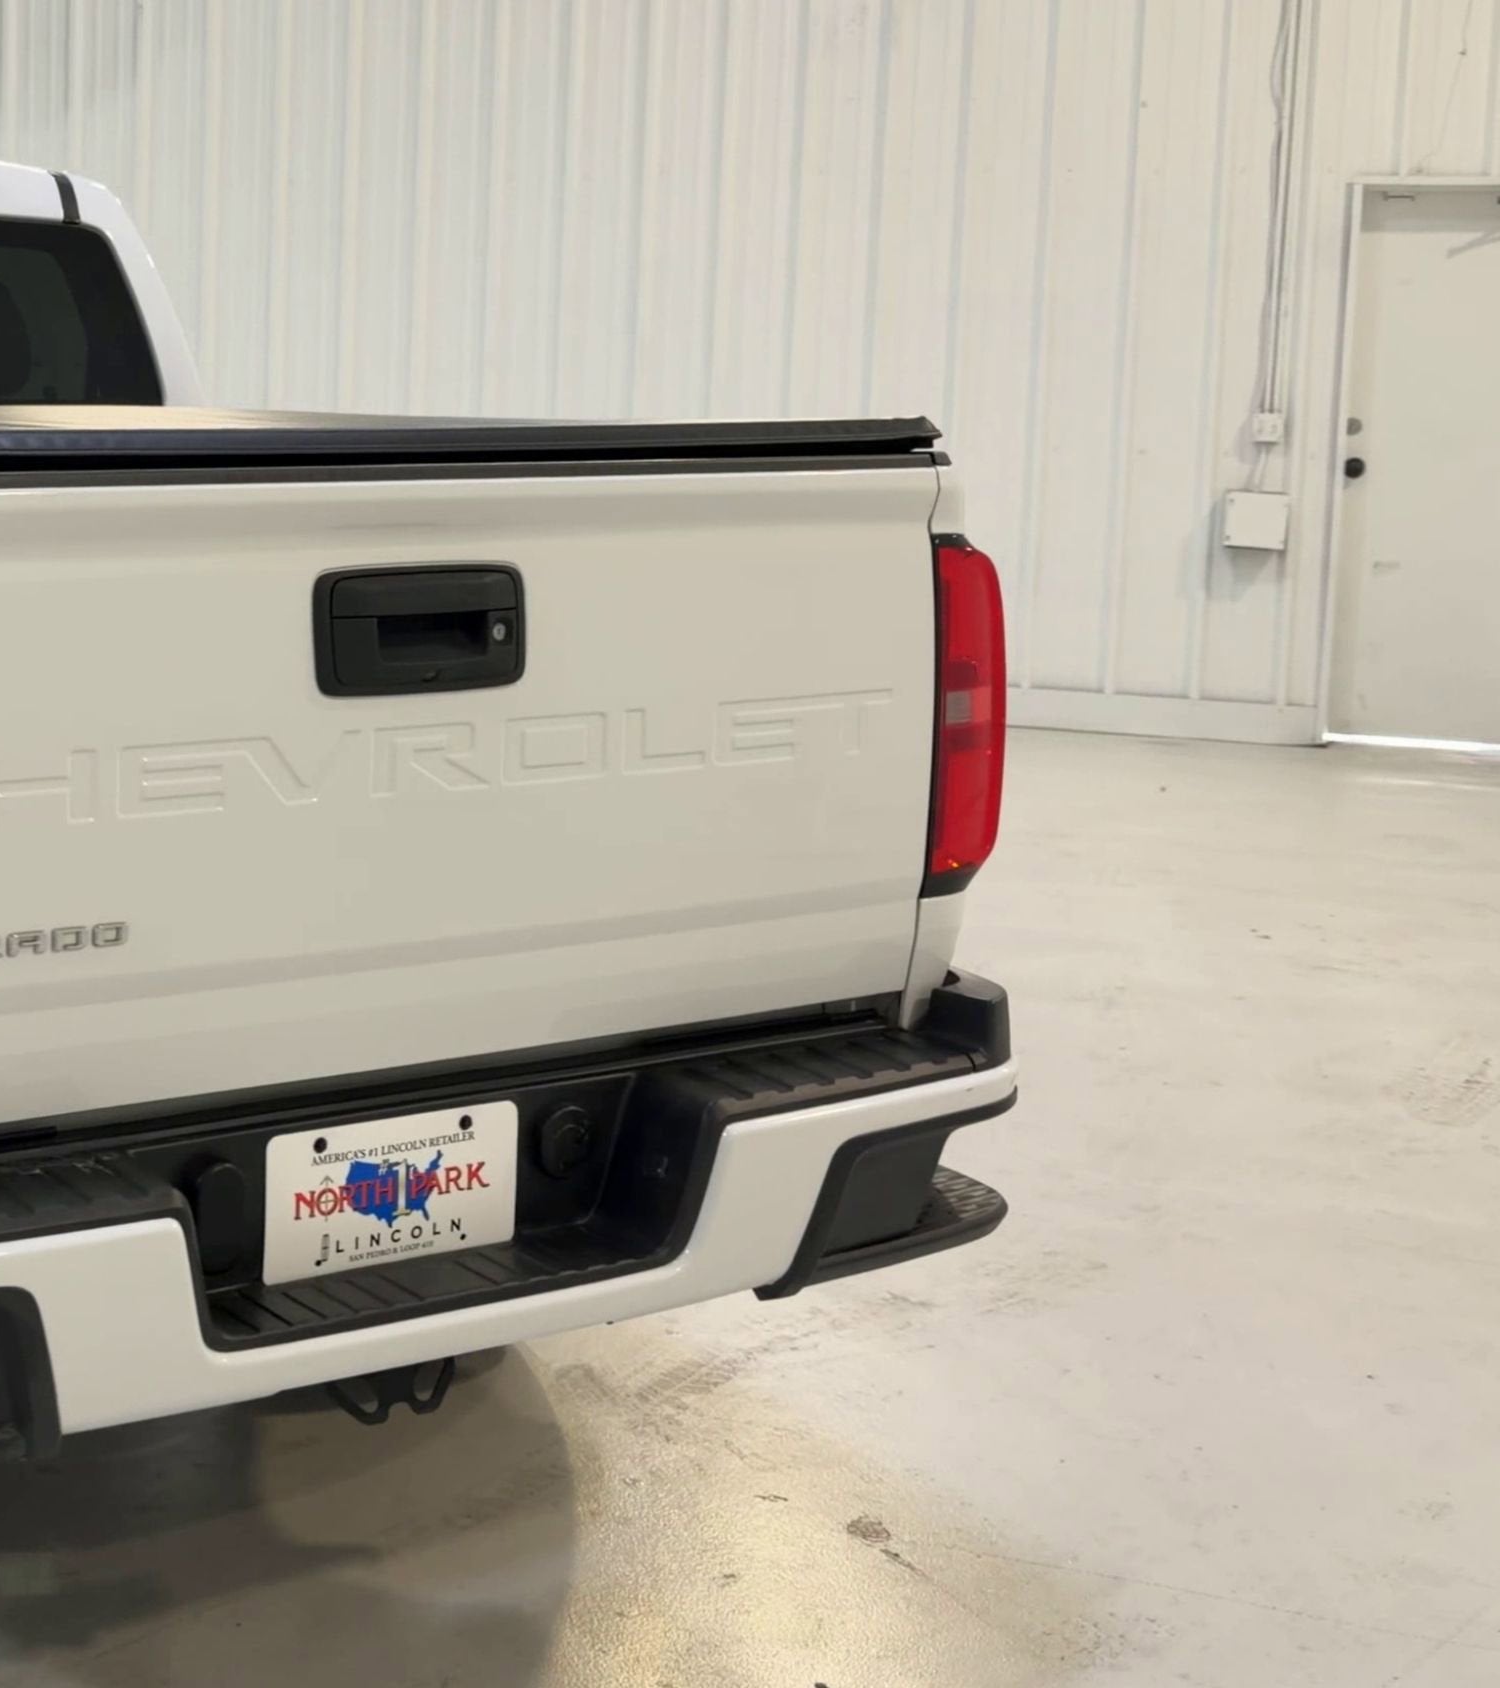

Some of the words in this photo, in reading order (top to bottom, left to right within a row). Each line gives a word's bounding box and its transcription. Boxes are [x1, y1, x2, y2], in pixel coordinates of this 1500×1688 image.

[311, 1147, 367, 1167] AMERICA'S
[368, 1148, 379, 1157] #1
[380, 1138, 427, 1156] LINCOLN
[428, 1130, 476, 1147] RETAILER
[293, 1178, 394, 1220] NORTH
[411, 1161, 490, 1199] PARK
[334, 1218, 462, 1254] LINCOLN
[366, 1248, 392, 1261] PEDRO
